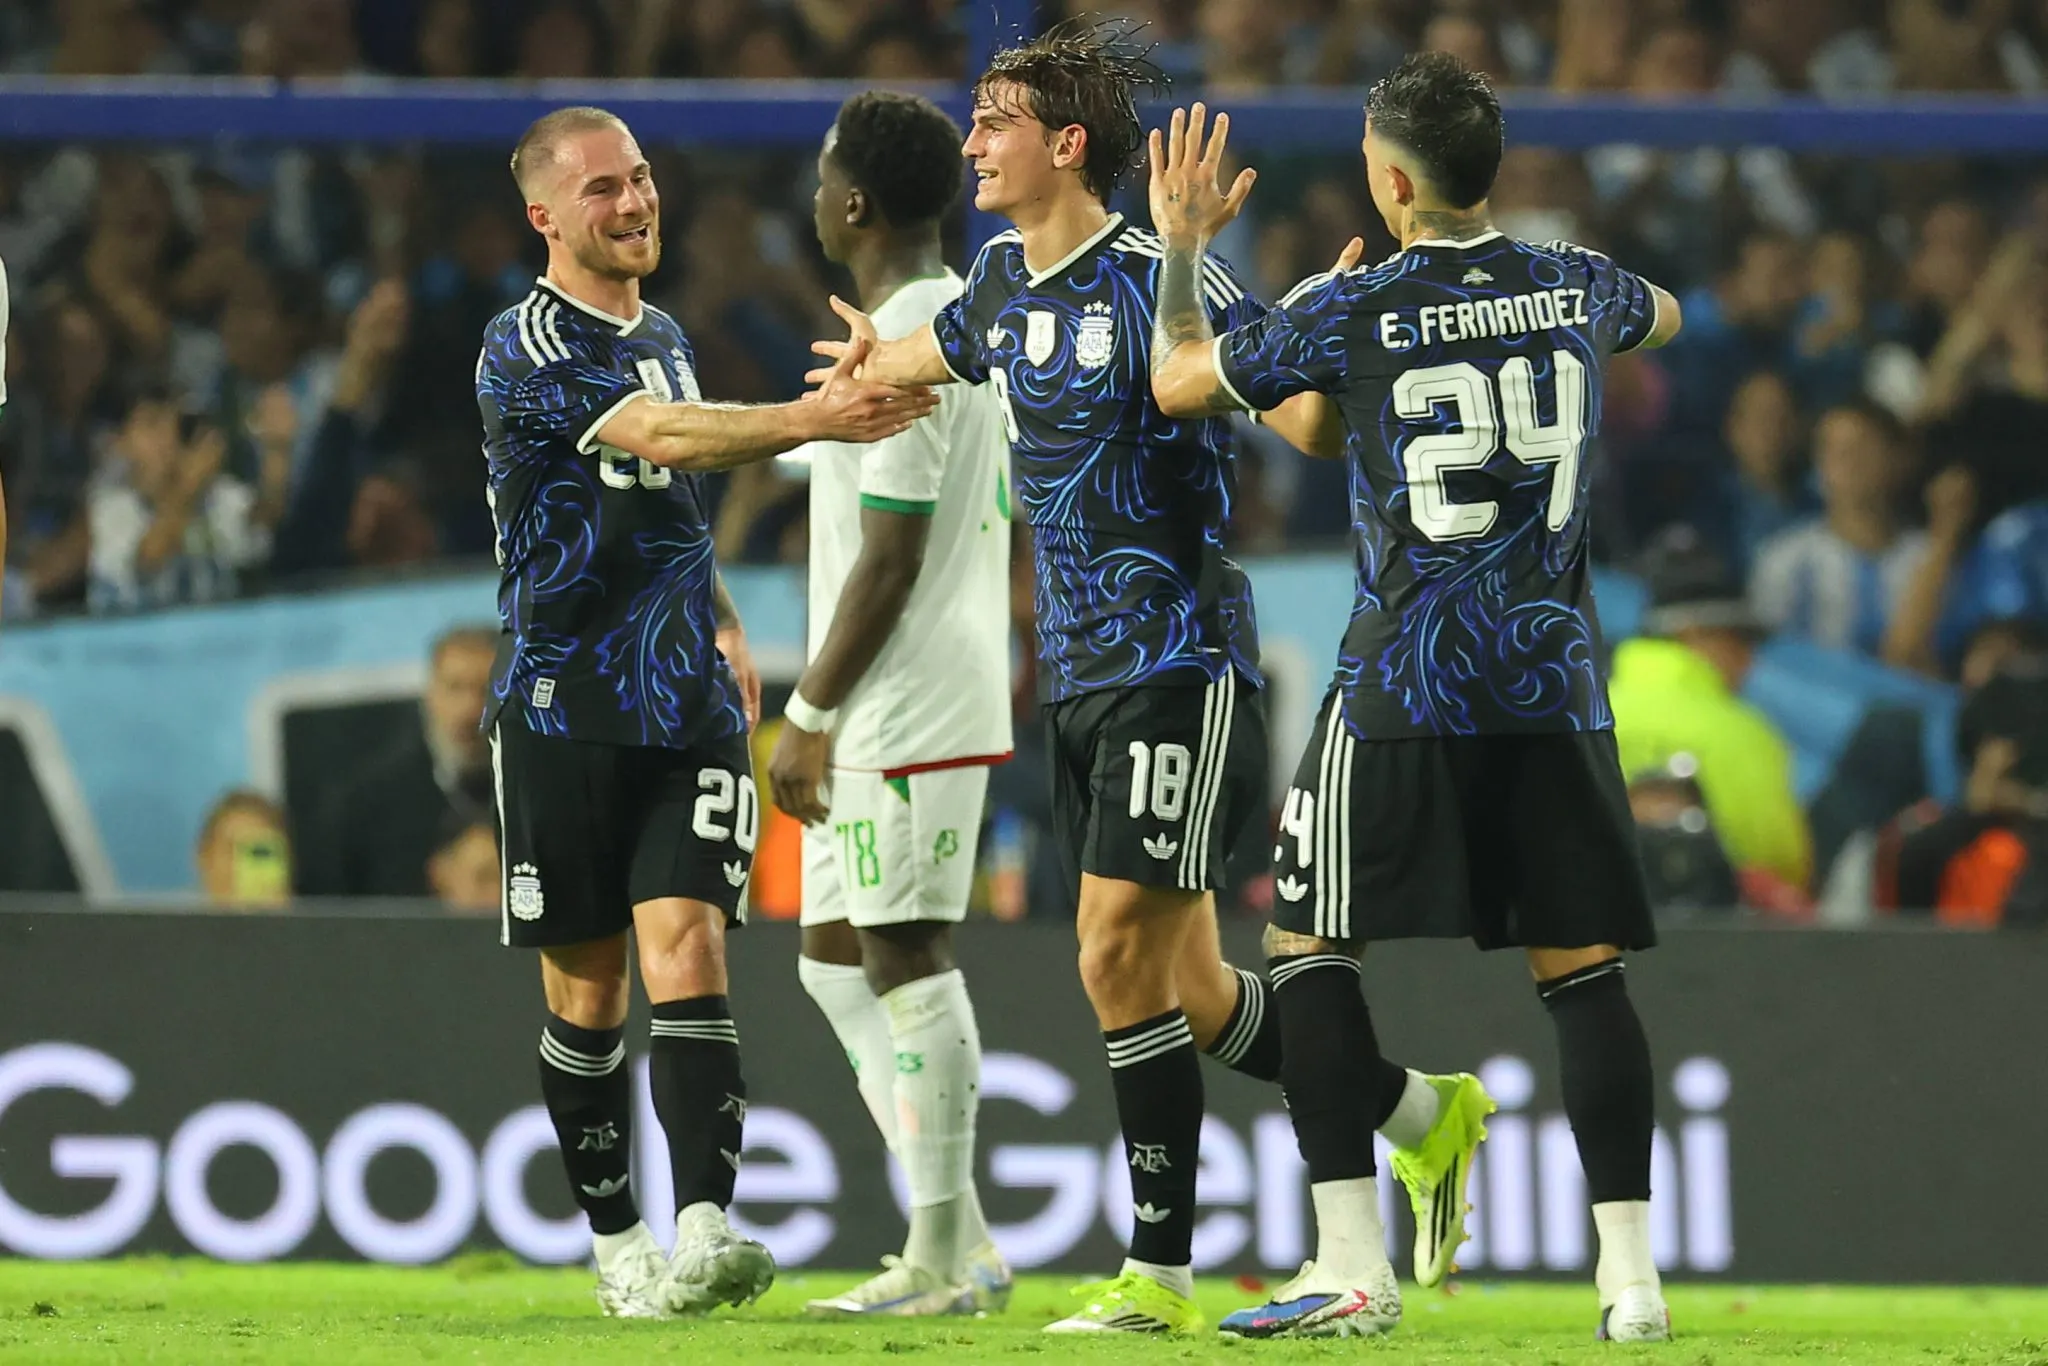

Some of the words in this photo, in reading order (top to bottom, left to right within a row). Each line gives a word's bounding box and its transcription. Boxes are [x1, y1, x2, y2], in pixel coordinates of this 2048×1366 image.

[1380, 312, 1410, 349] E.
[1419, 288, 1589, 346] FERNANDEZ
[1392, 350, 1585, 542] 24
[692, 768, 758, 853] 20
[1129, 741, 1191, 821] 18
[1275, 786, 1314, 868] 4
